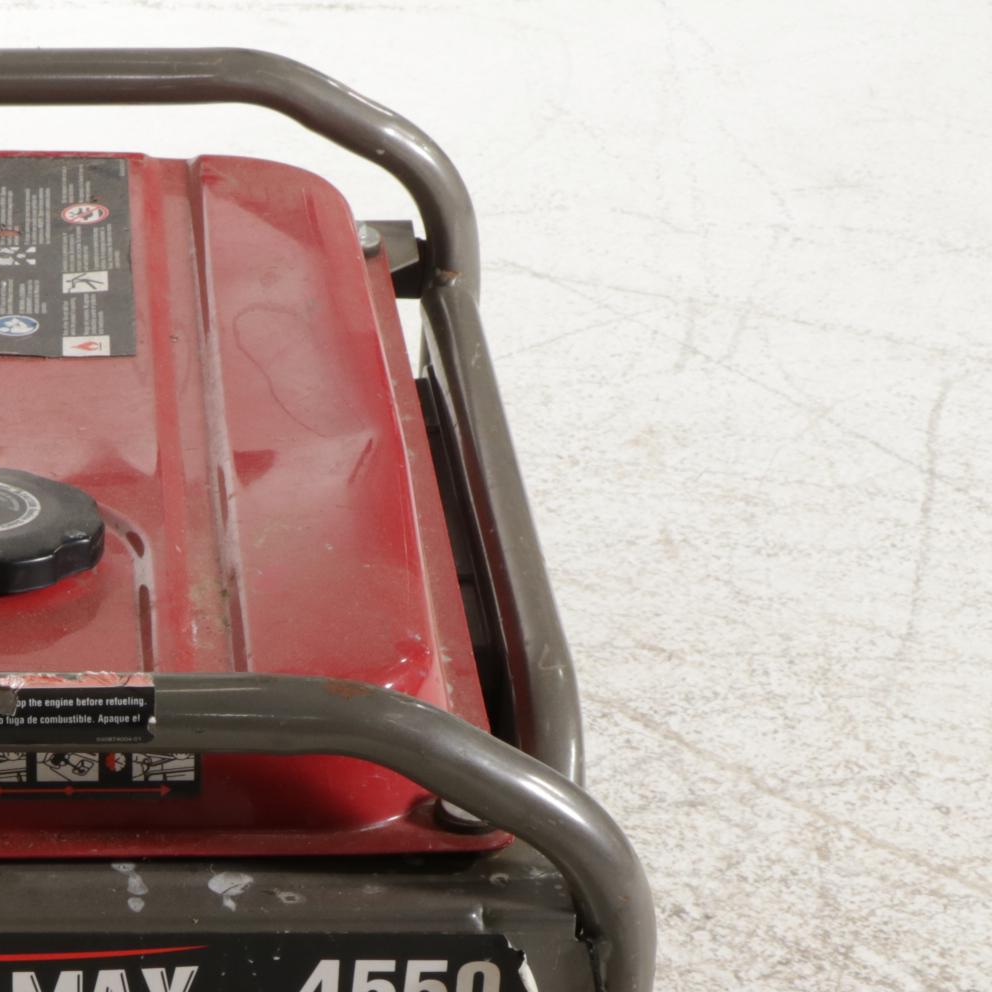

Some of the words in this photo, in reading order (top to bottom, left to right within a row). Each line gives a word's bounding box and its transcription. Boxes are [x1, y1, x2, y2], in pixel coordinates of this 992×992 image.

[29, 698, 43, 707] the
[44, 699, 74, 709] engine
[76, 697, 104, 707] before
[105, 697, 148, 708] refueling.
[6, 716, 25, 727] fuga
[27, 716, 38, 725] de
[40, 714, 95, 724] combustible.
[97, 714, 130, 725] Apaque
[132, 713, 141, 723] el
